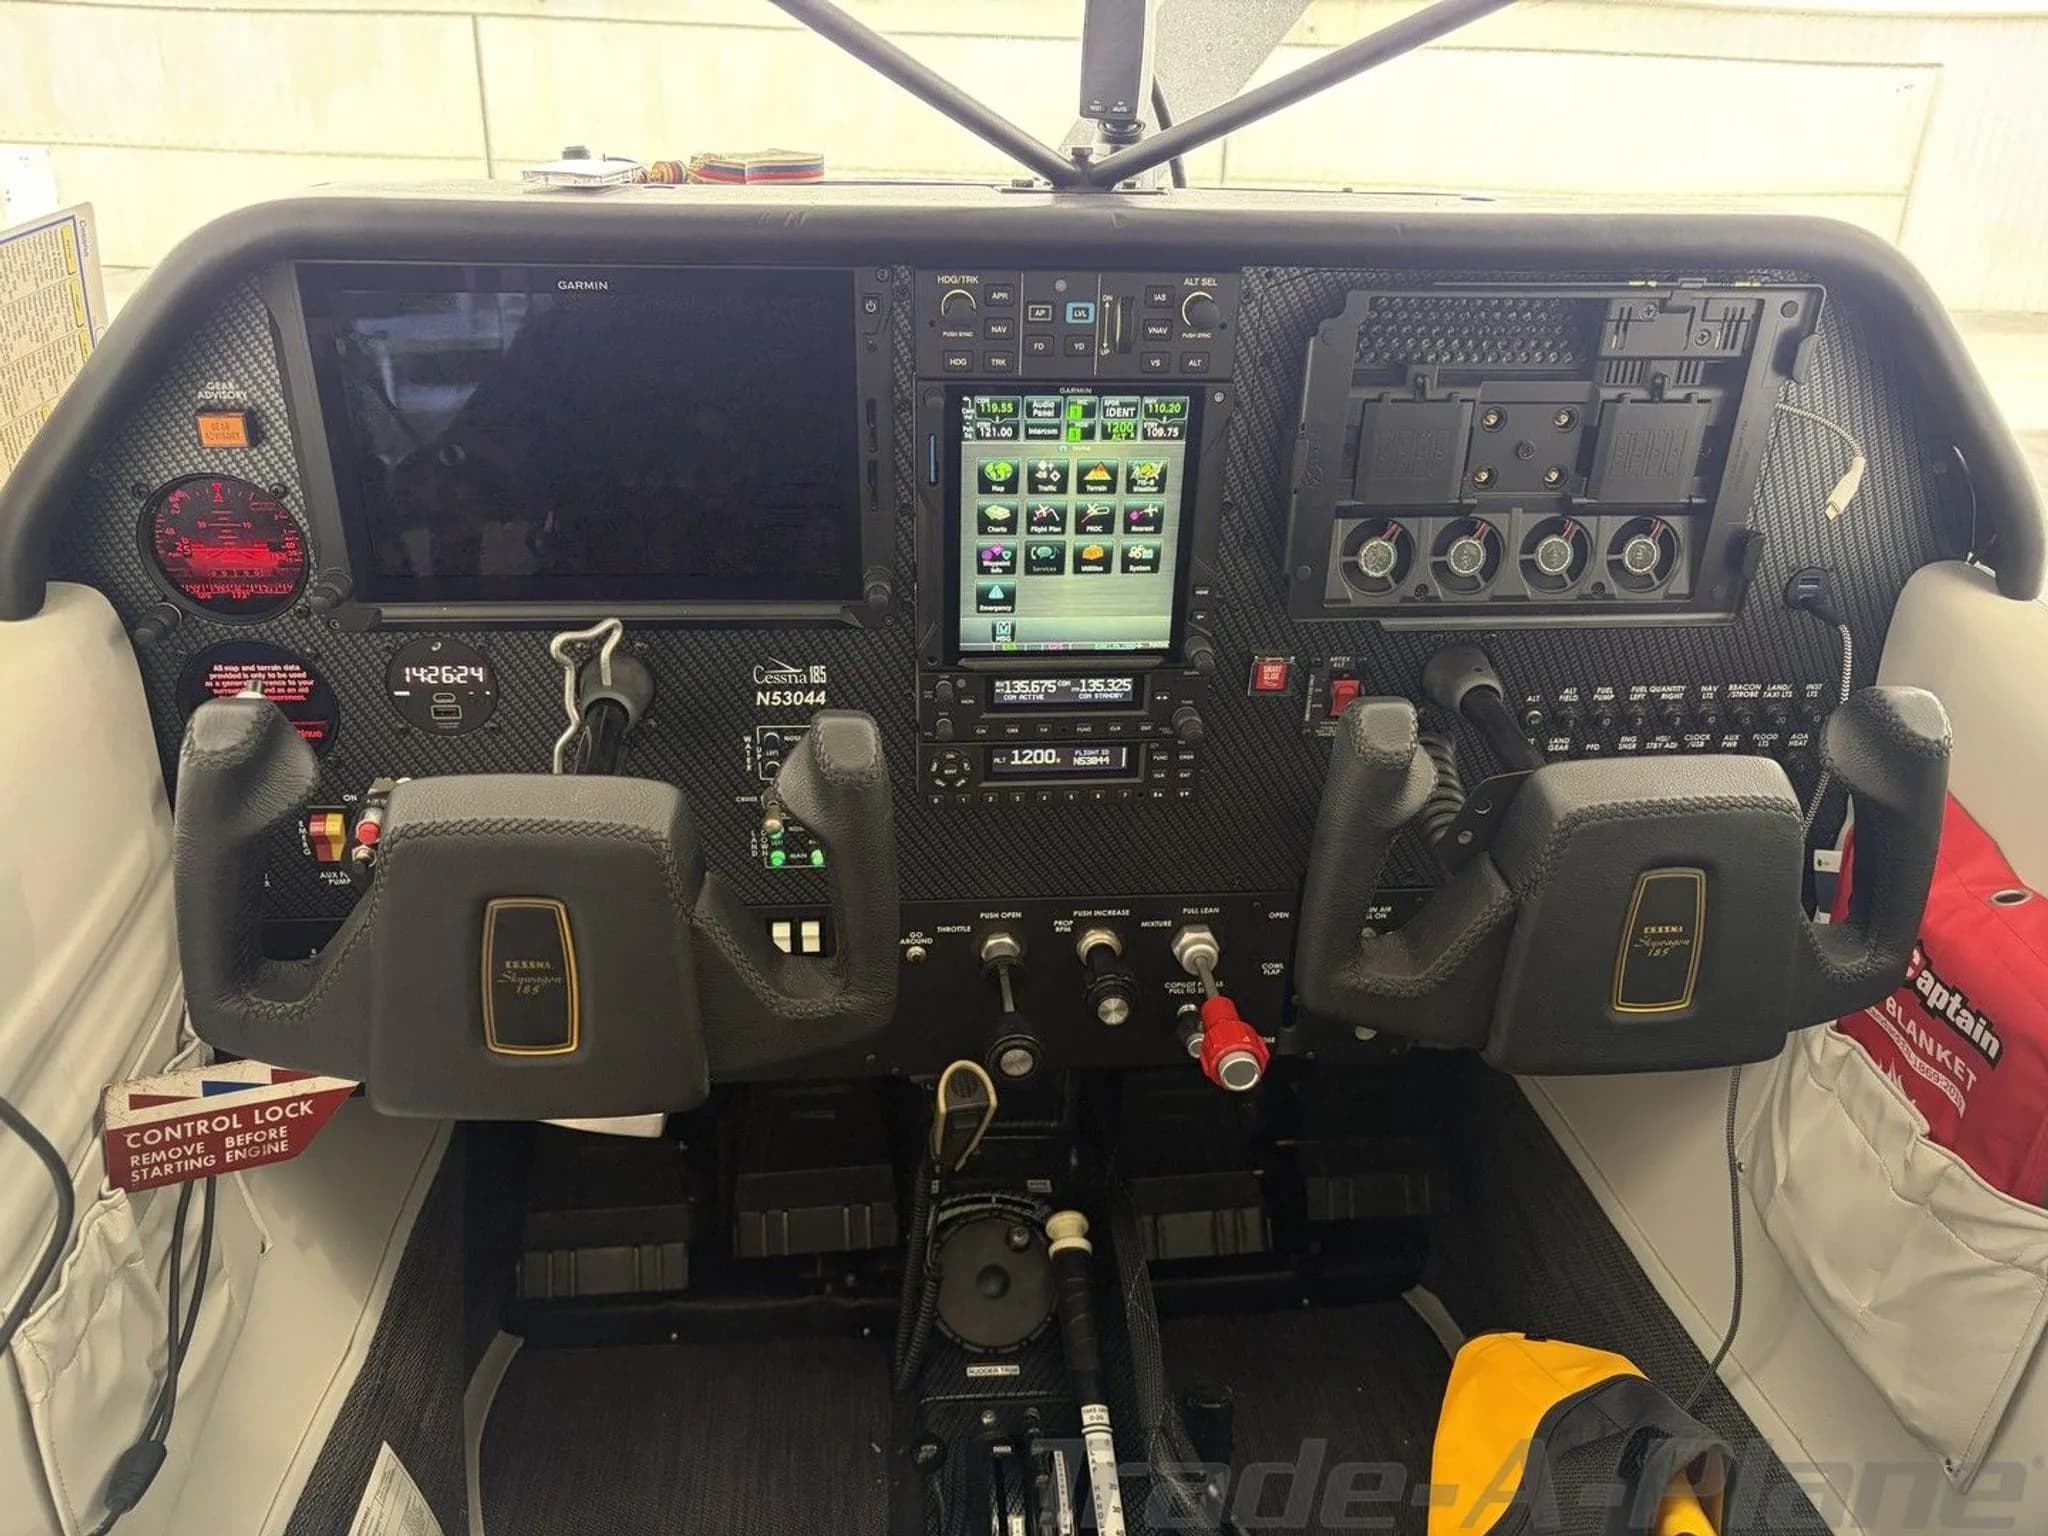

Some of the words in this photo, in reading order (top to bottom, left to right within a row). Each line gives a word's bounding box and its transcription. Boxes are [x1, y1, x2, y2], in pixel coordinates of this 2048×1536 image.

[937, 275, 980, 284] HDG/TRK
[1183, 278, 1199, 287] ALT
[1201, 278, 1218, 287] SEL
[557, 280, 608, 291] GARMIN
[991, 291, 1009, 300] APR
[1153, 293, 1167, 302] IAS
[1034, 309, 1046, 317] AP
[1073, 309, 1088, 318] LVL
[991, 325, 1007, 334] NAV
[1147, 327, 1168, 335] VNAV
[1033, 342, 1045, 351] FD
[949, 357, 968, 366] HDG
[991, 358, 1008, 366] TRK
[1150, 359, 1161, 367] VS
[1188, 359, 1203, 367] ALT
[1059, 386, 1093, 395] GARMIN
[197, 391, 248, 400] ADVISORY
[980, 402, 1014, 413] 119.55
[1032, 400, 1056, 409] Audio
[1148, 402, 1182, 414] 110.20
[1032, 409, 1055, 417] Panel
[1105, 407, 1137, 418] IDENT
[1107, 421, 1134, 433] 1200
[979, 426, 1013, 438] 121.00
[1028, 428, 1059, 436] Intercom
[1146, 427, 1180, 438] 109.75
[241, 664, 255, 672] and
[256, 664, 282, 672] terrain
[753, 665, 808, 685] Cessna
[809, 665, 827, 684] 185
[1004, 679, 1057, 693] 135.675
[1079, 678, 1133, 692] 135.325
[1630, 685, 1648, 693] FUEL
[1649, 684, 1687, 692] QUANTITY
[1727, 683, 1761, 691] BEACON
[1766, 683, 1793, 691] LAND/
[1596, 686, 1613, 694] FUEL
[1781, 690, 1793, 698] LTS
[756, 690, 827, 706] N53044
[1629, 693, 1646, 701] LEFT
[1548, 736, 1571, 744] LAND
[1620, 735, 1638, 743] ENG
[1683, 733, 1711, 741] CLOCK
[1752, 733, 1779, 741] FLOOD
[1585, 743, 1601, 751] PFD
[1010, 748, 1057, 765] 1200
[343, 793, 358, 802] ON
[320, 871, 339, 879] AUX
[1000, 911, 1023, 919] OPEN
[1093, 909, 1130, 917] INCREASE
[1182, 907, 1200, 915] PULL
[1200, 906, 1220, 914] LEAN
[1268, 911, 1290, 919] OPEN
[1053, 919, 1075, 927] PROP
[1140, 919, 1172, 928] MIXTURE
[936, 925, 972, 933] THROTTLE
[909, 931, 924, 939] GO
[1164, 981, 1197, 989] COPILOT
[1168, 987, 1185, 995] PULL
[1186, 987, 1197, 995] TO
[1886, 995, 1978, 1097] BLANKET
[124, 1112, 243, 1149] CONTROL
[253, 1099, 315, 1126] LOCK
[130, 1141, 206, 1168] REMOVE
[224, 1125, 289, 1150] BEFORE
[131, 1154, 217, 1182] STARTING
[225, 1139, 290, 1164] ENGINE
